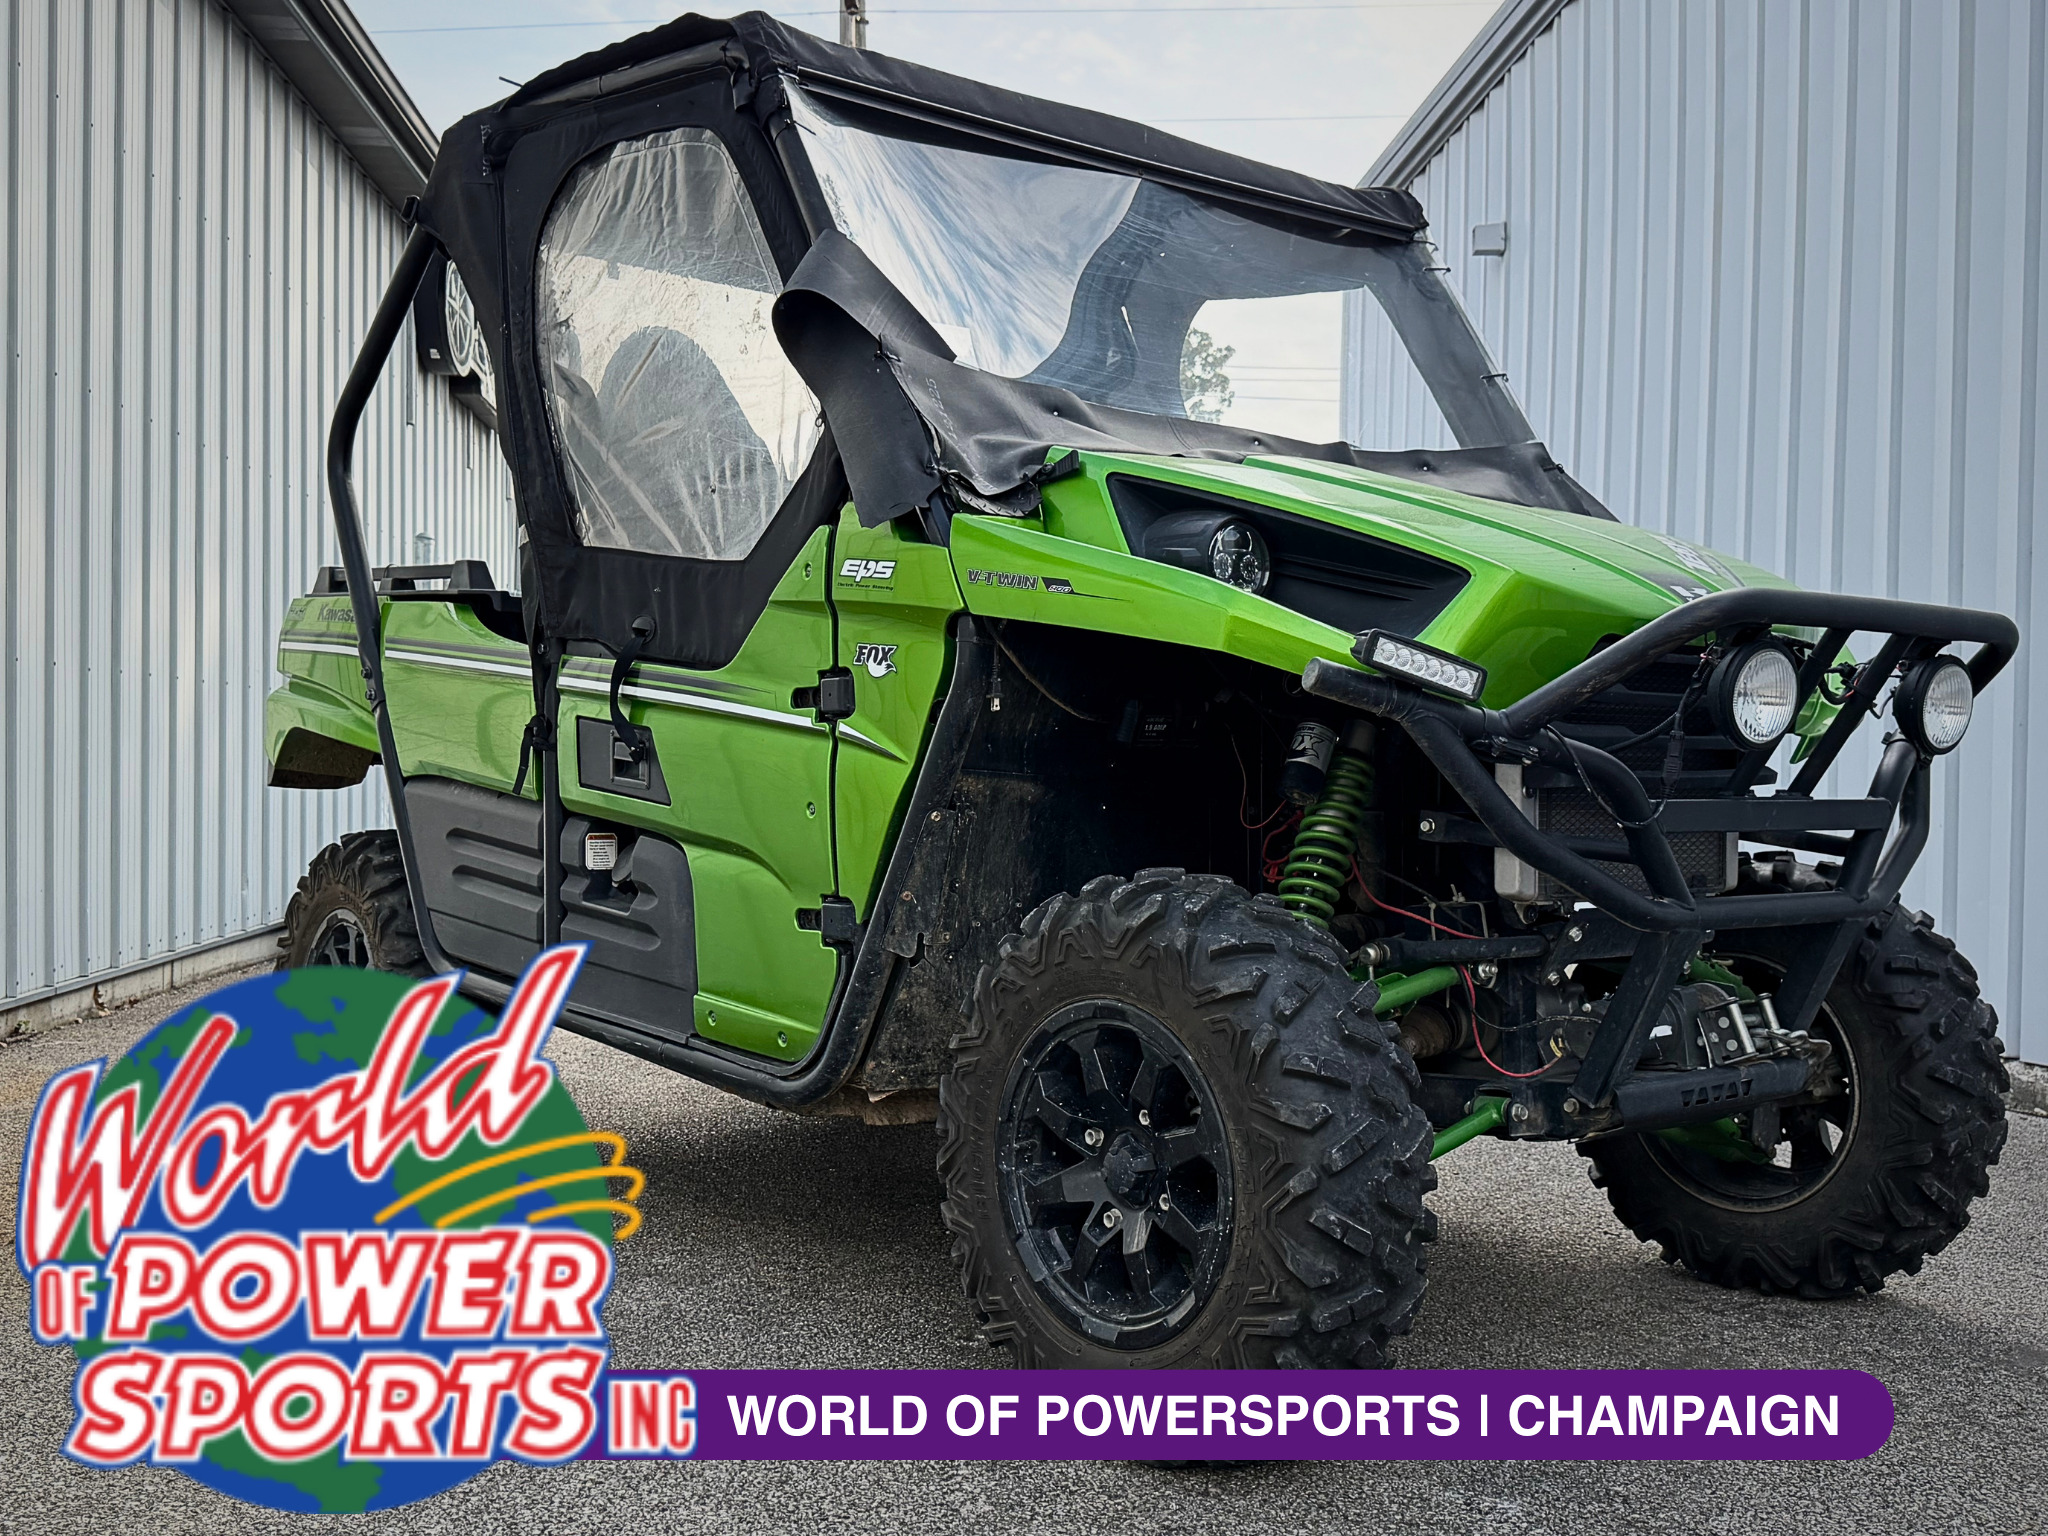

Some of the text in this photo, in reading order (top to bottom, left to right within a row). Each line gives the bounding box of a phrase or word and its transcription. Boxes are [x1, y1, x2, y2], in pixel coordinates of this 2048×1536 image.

[967, 568, 1038, 590] V-TWIN
[317, 603, 356, 622] Kawas
[853, 642, 898, 666] FOX
